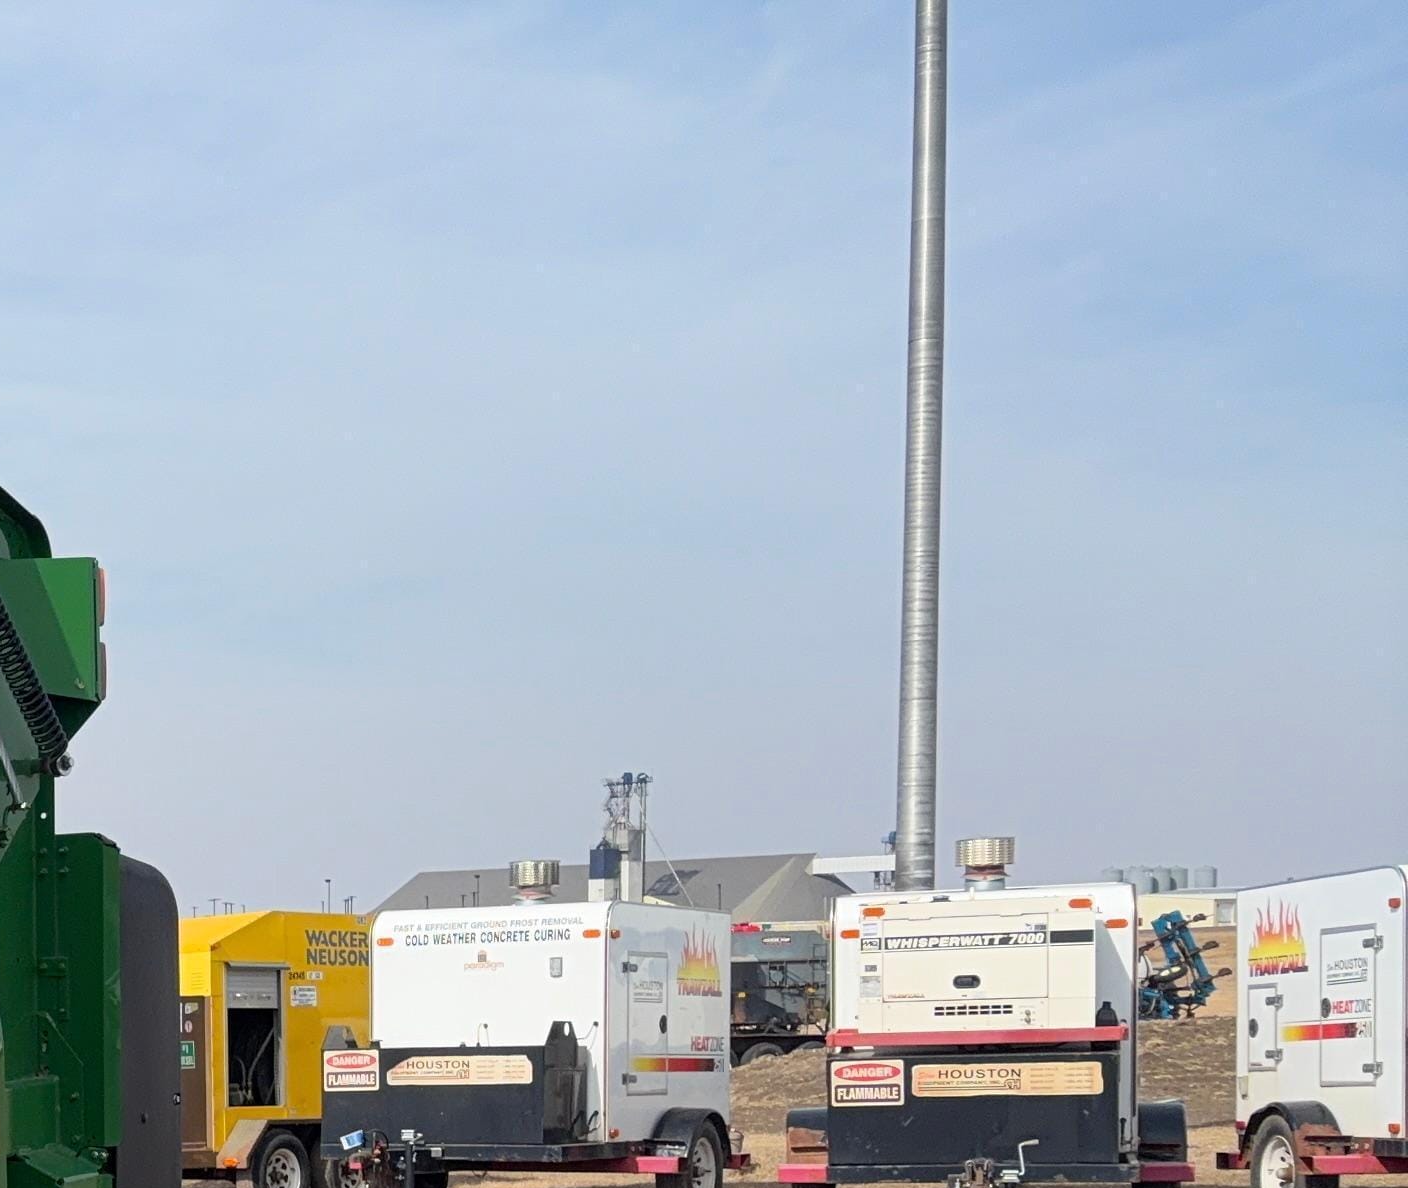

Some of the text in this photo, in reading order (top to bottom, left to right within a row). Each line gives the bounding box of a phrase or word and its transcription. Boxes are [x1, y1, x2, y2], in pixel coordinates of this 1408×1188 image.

[394, 924, 414, 932] FAST
[425, 921, 468, 931] EFFICIENT
[471, 919, 508, 930] GROUND
[510, 918, 539, 928] FROST
[541, 917, 584, 926] REMOVAL
[305, 929, 370, 948] WACKER
[405, 928, 571, 946] COLD WEATHER CONCRETE CURING
[886, 931, 1045, 950] WHISPERWATT 7000
[306, 949, 370, 967] NEUSON
[1334, 957, 1368, 970] HOUSTON
[333, 1055, 371, 1066] DANGER
[406, 1060, 471, 1070] HOUSTON
[842, 1067, 893, 1078] DANGER
[938, 1068, 1022, 1079] HOUSTON
[328, 1073, 376, 1086] FLAMMABLE
[837, 1086, 899, 1100] FLAMMABLE
